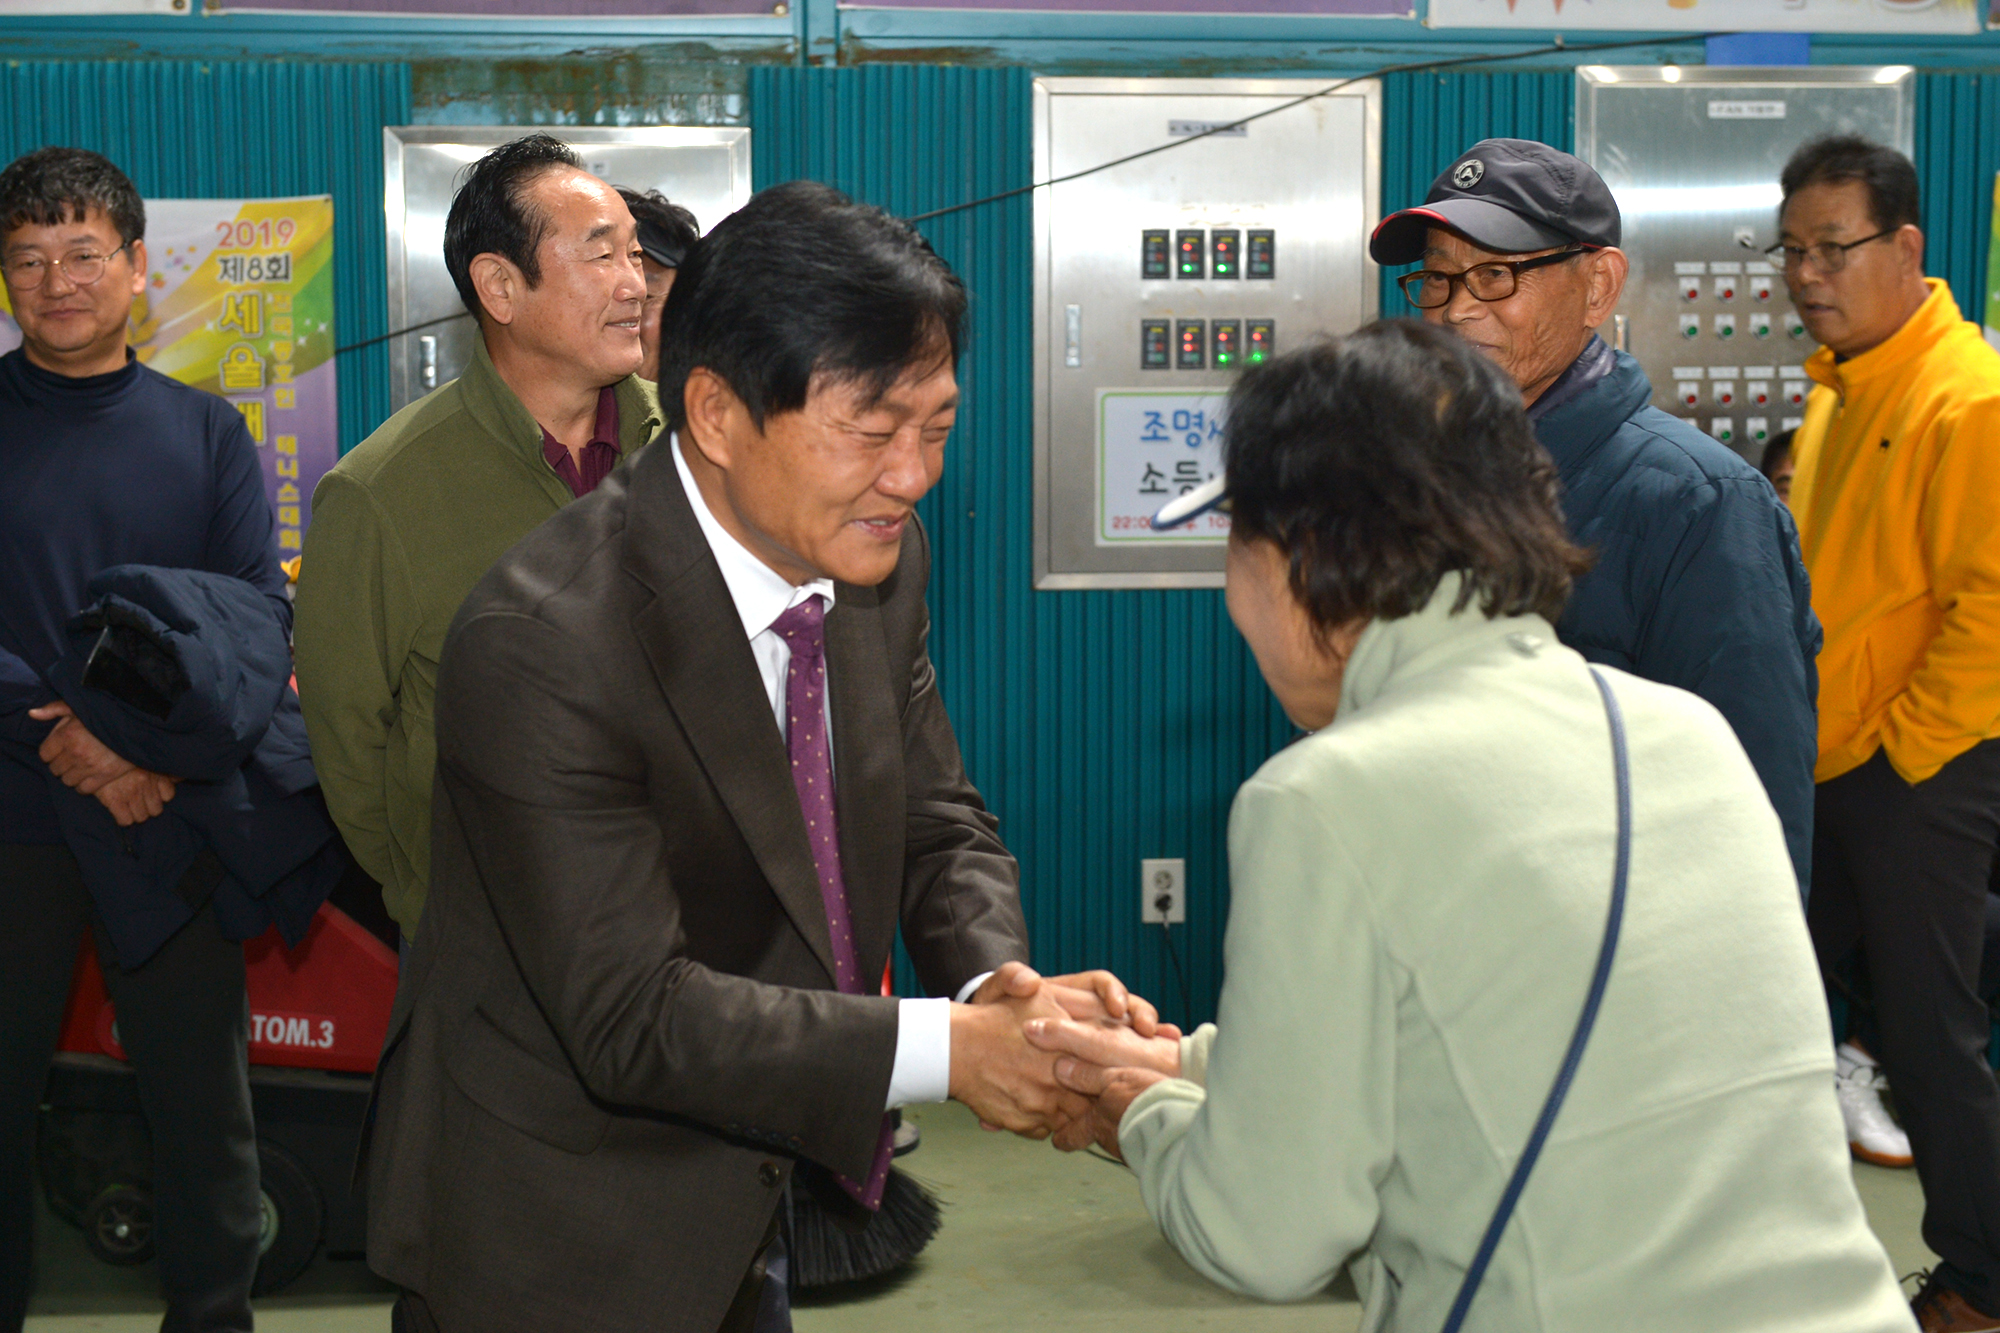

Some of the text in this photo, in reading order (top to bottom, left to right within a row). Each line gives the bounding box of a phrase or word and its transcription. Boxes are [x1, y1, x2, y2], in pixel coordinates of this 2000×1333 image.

[216, 219, 295, 247] 2019
[218, 254, 291, 282] 제8회
[1139, 462, 1214, 497] 소등
[249, 1014, 335, 1048] TOM.3
